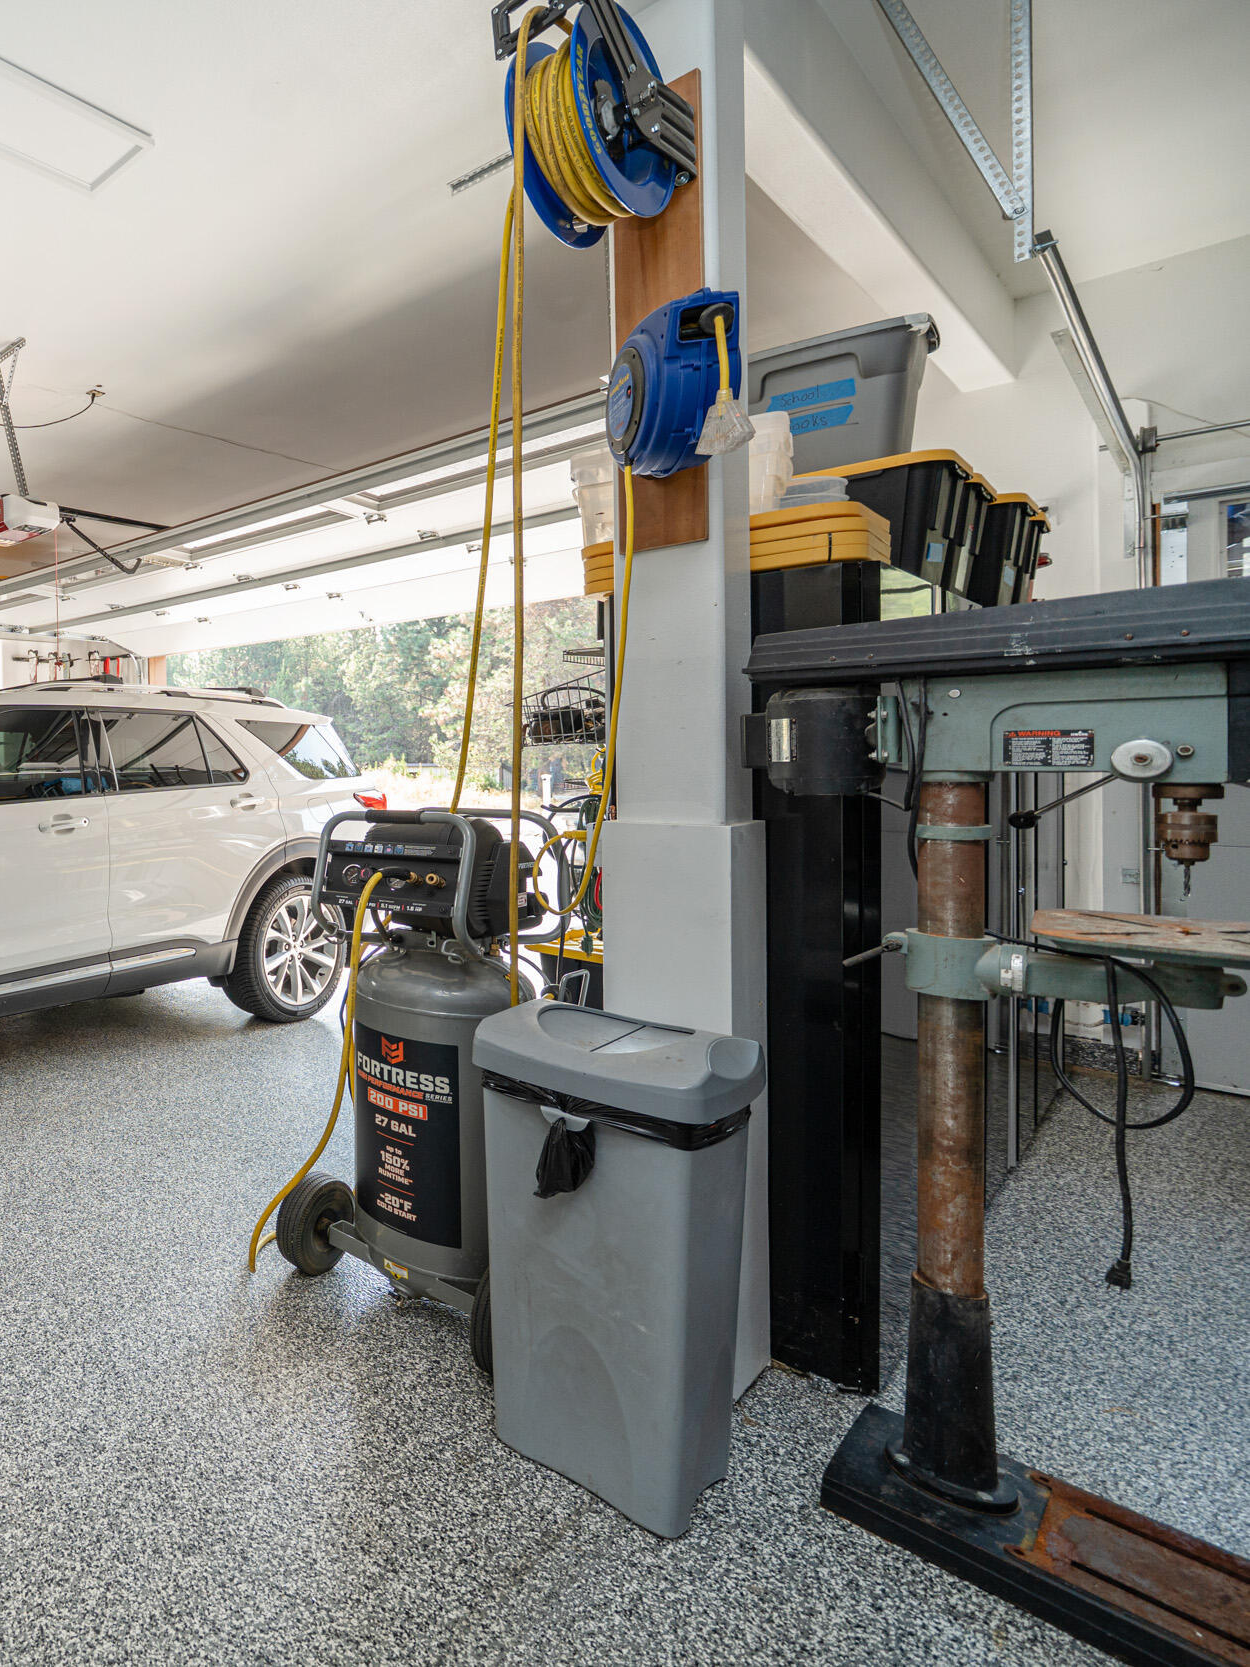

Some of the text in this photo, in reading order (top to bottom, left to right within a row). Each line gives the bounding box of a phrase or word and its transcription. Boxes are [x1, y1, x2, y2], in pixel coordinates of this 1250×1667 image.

[576, 43, 601, 154] GOODYEAR
[780, 383, 820, 408] School
[790, 415, 828, 431] ooks
[357, 1050, 450, 1095] FORTRESS
[367, 1076, 425, 1100] PERFORMANCE
[425, 1093, 453, 1102] SERIES
[369, 1090, 424, 1118] 200 PSI
[374, 1113, 417, 1137] 27 GAL
[380, 1150, 410, 1171] 150%
[385, 1144, 402, 1155] up to
[384, 1163, 405, 1177] MORE
[376, 1199, 417, 1222] COLD START
[379, 1192, 412, 1212] -20°F
